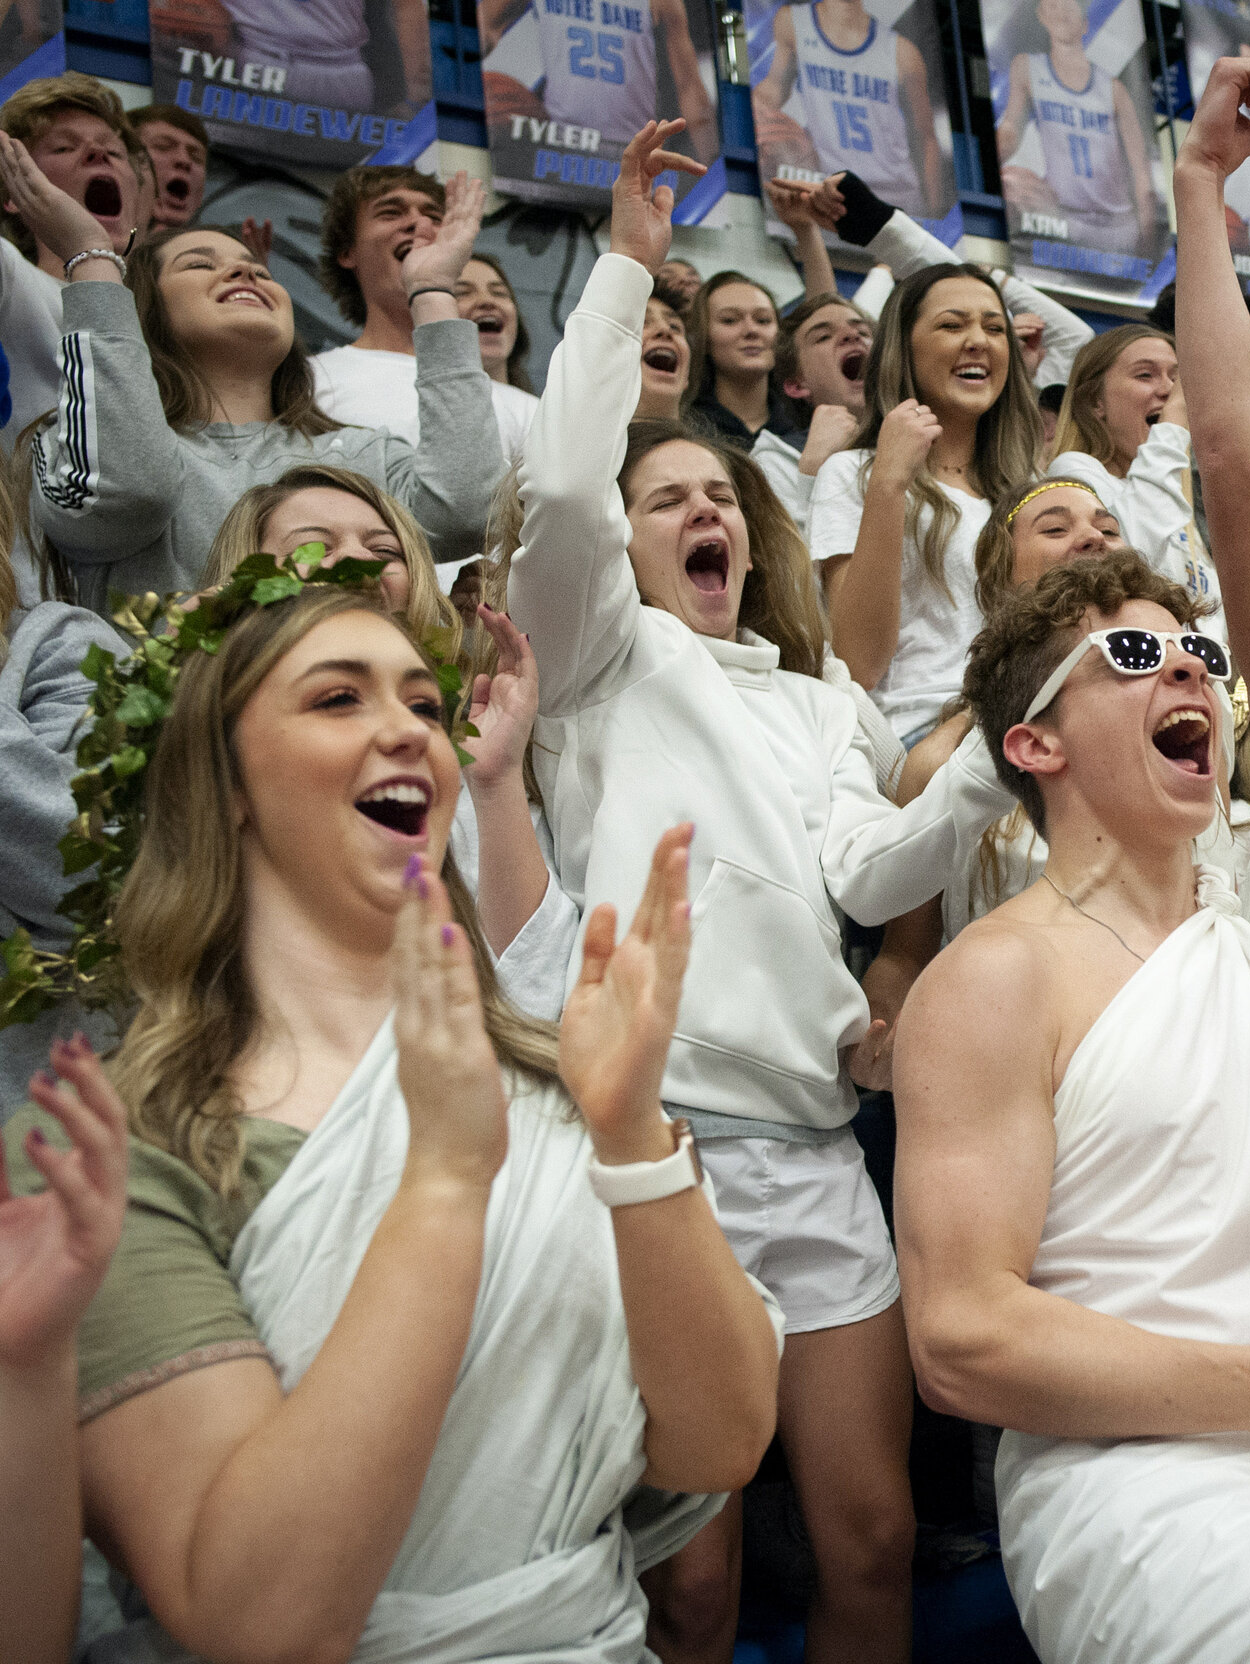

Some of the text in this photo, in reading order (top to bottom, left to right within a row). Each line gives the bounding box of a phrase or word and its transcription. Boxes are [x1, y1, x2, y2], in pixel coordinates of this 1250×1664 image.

[178, 46, 287, 94] TYLER
[567, 26, 625, 85] 25
[175, 79, 410, 146] LANDEWEE
[511, 114, 600, 151] TYLER
[832, 101, 873, 153] 15
[1068, 134, 1092, 178] 11
